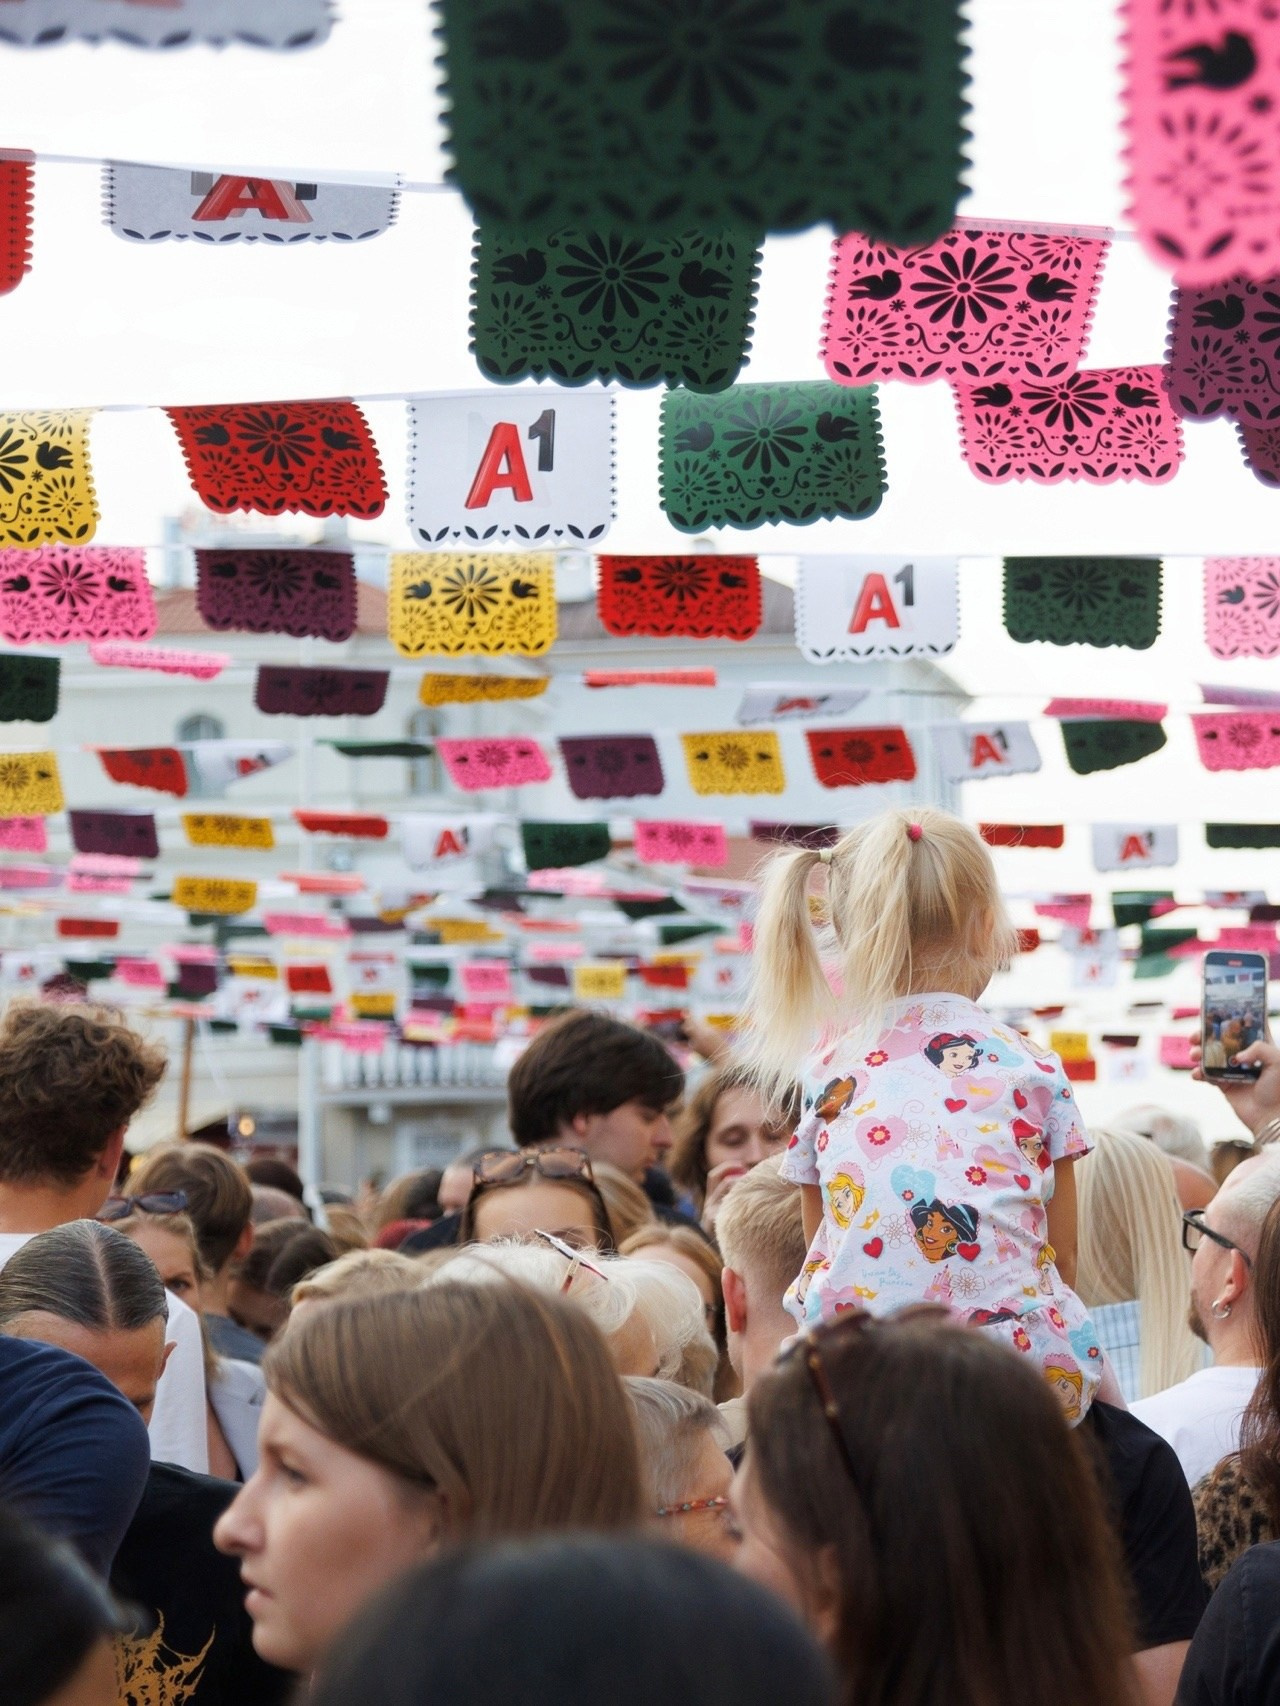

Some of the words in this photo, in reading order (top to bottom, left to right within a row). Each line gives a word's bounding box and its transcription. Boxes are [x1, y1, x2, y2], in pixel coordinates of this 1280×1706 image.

[465, 409, 555, 509] A1
[847, 564, 914, 634] A1
[972, 730, 1008, 769] A1
[435, 826, 468, 859] A1
[1121, 831, 1154, 862] A1
